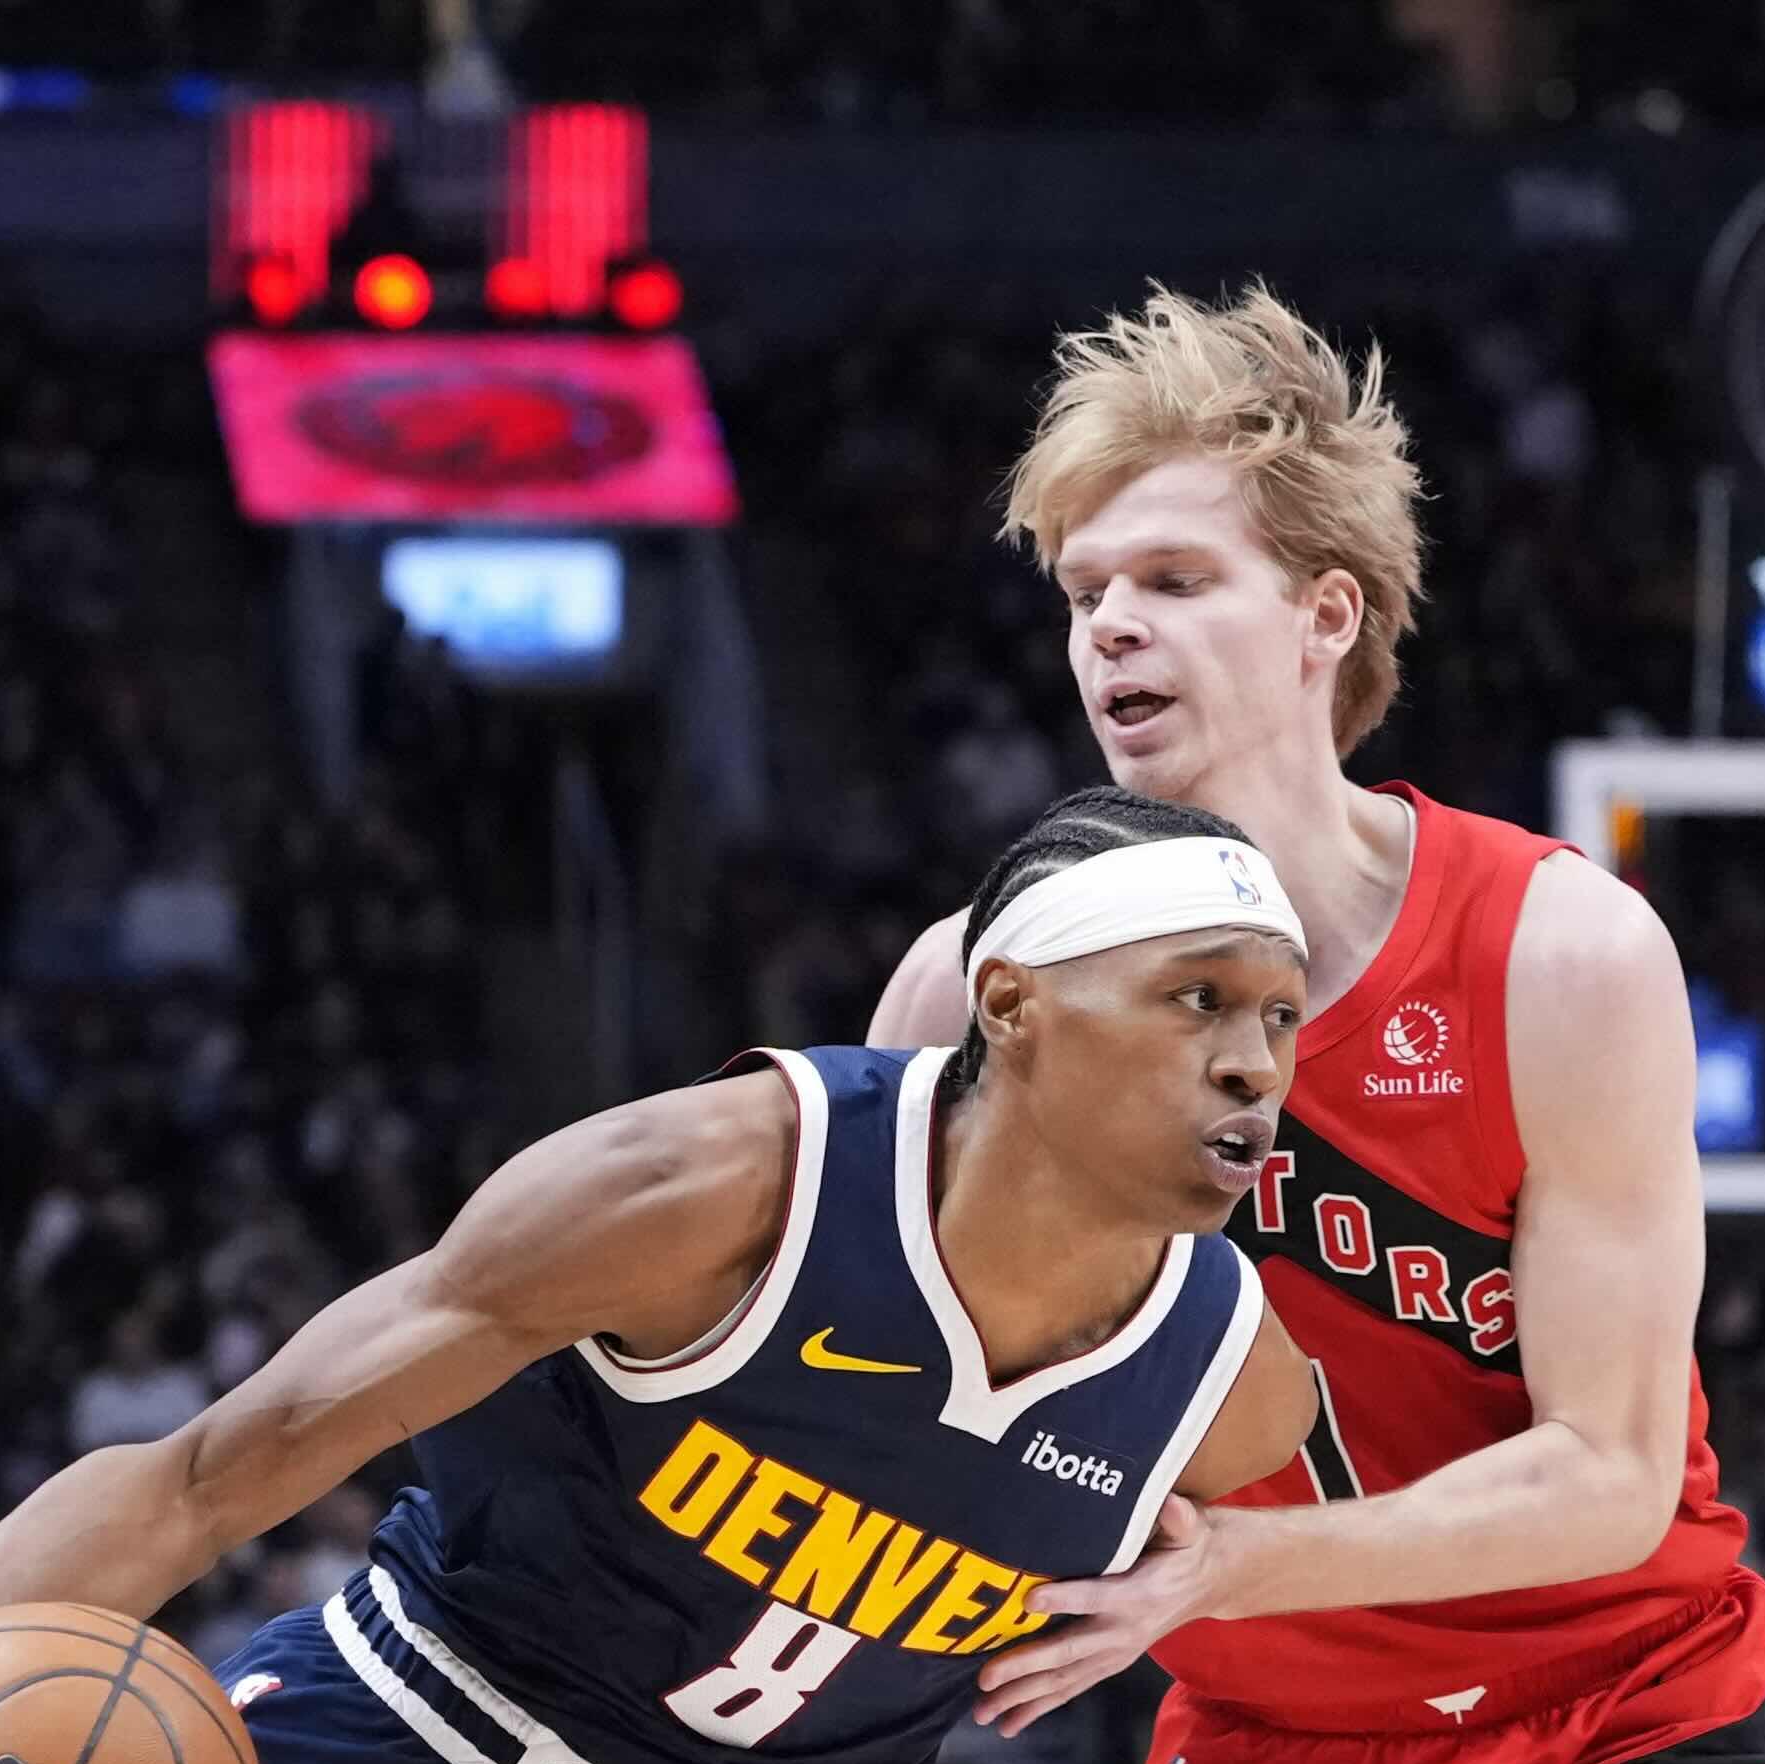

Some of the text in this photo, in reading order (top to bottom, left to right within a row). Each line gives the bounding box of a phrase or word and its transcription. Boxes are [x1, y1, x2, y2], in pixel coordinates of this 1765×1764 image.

[1364, 1068, 1464, 1096] Sun Life
[1021, 1431, 1124, 1497] ibotta
[663, 1599, 864, 1749] 8
